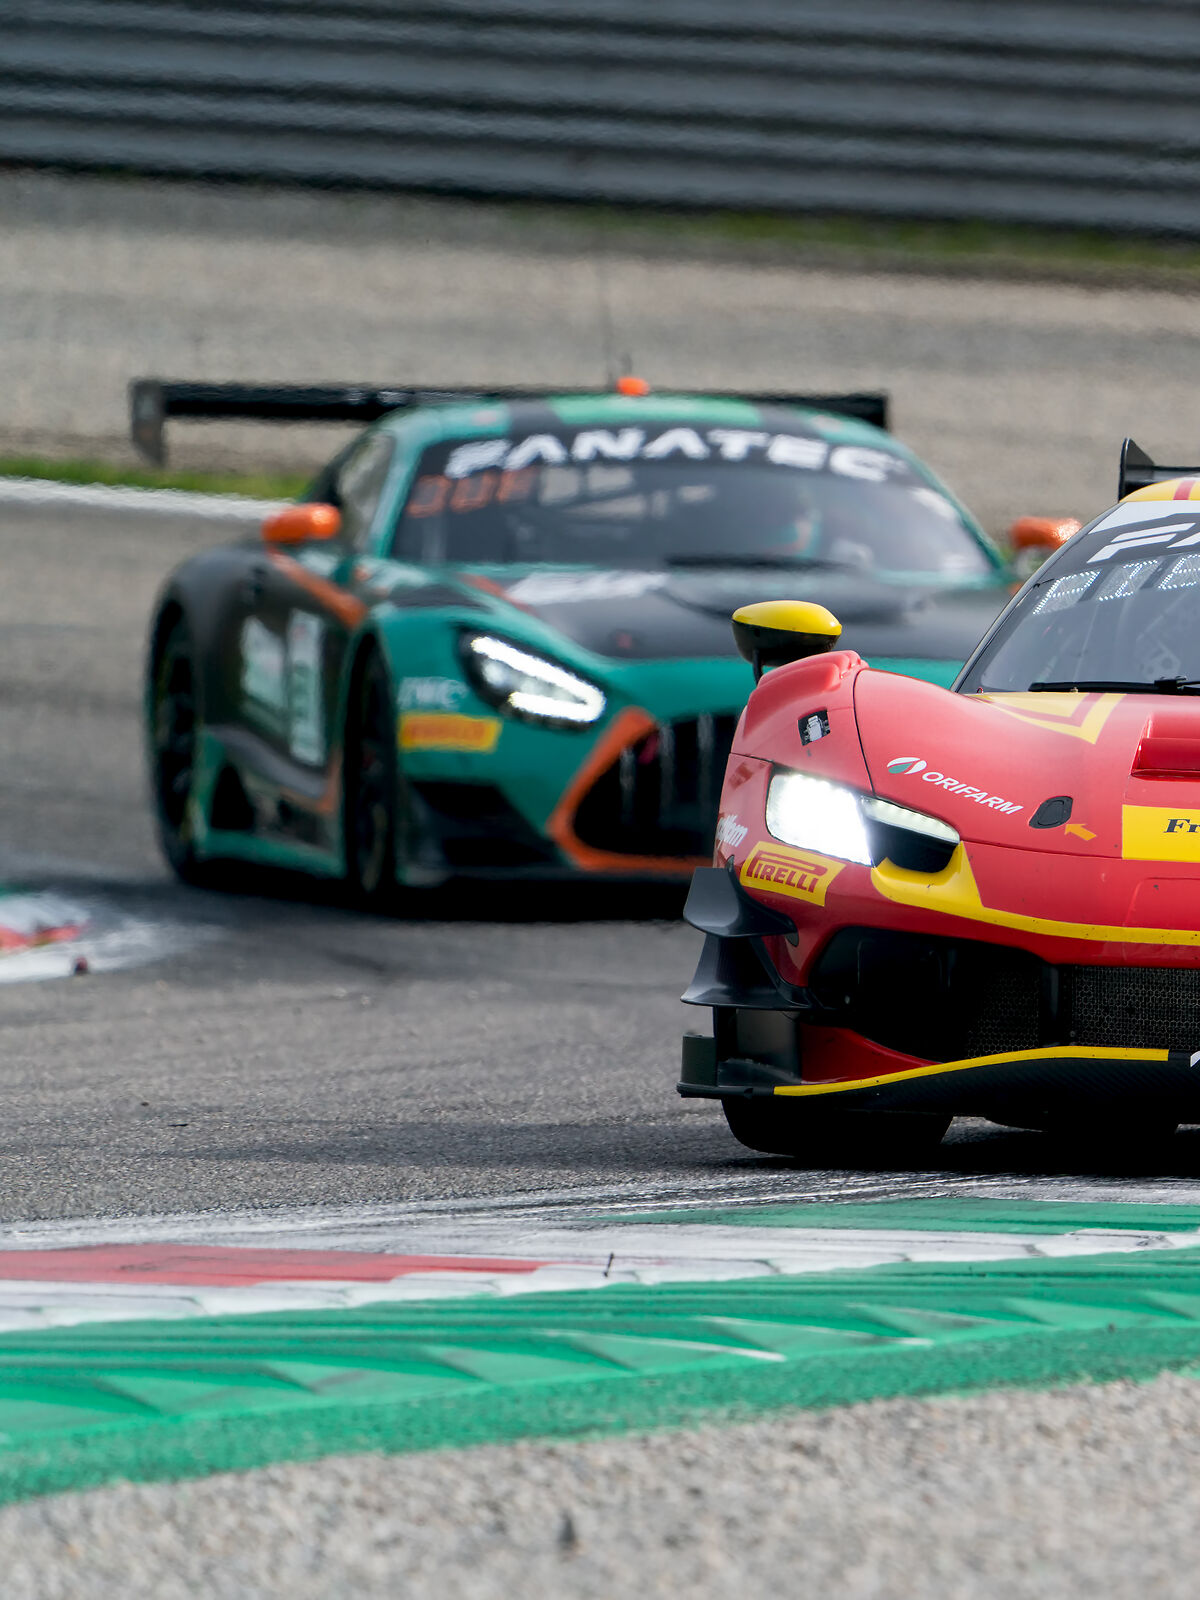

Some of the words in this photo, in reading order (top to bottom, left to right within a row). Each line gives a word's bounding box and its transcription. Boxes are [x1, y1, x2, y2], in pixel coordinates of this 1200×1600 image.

[445, 427, 897, 482] FANATEC
[922, 771, 1024, 815] ORIFARM
[746, 850, 828, 893] PIRELLI
